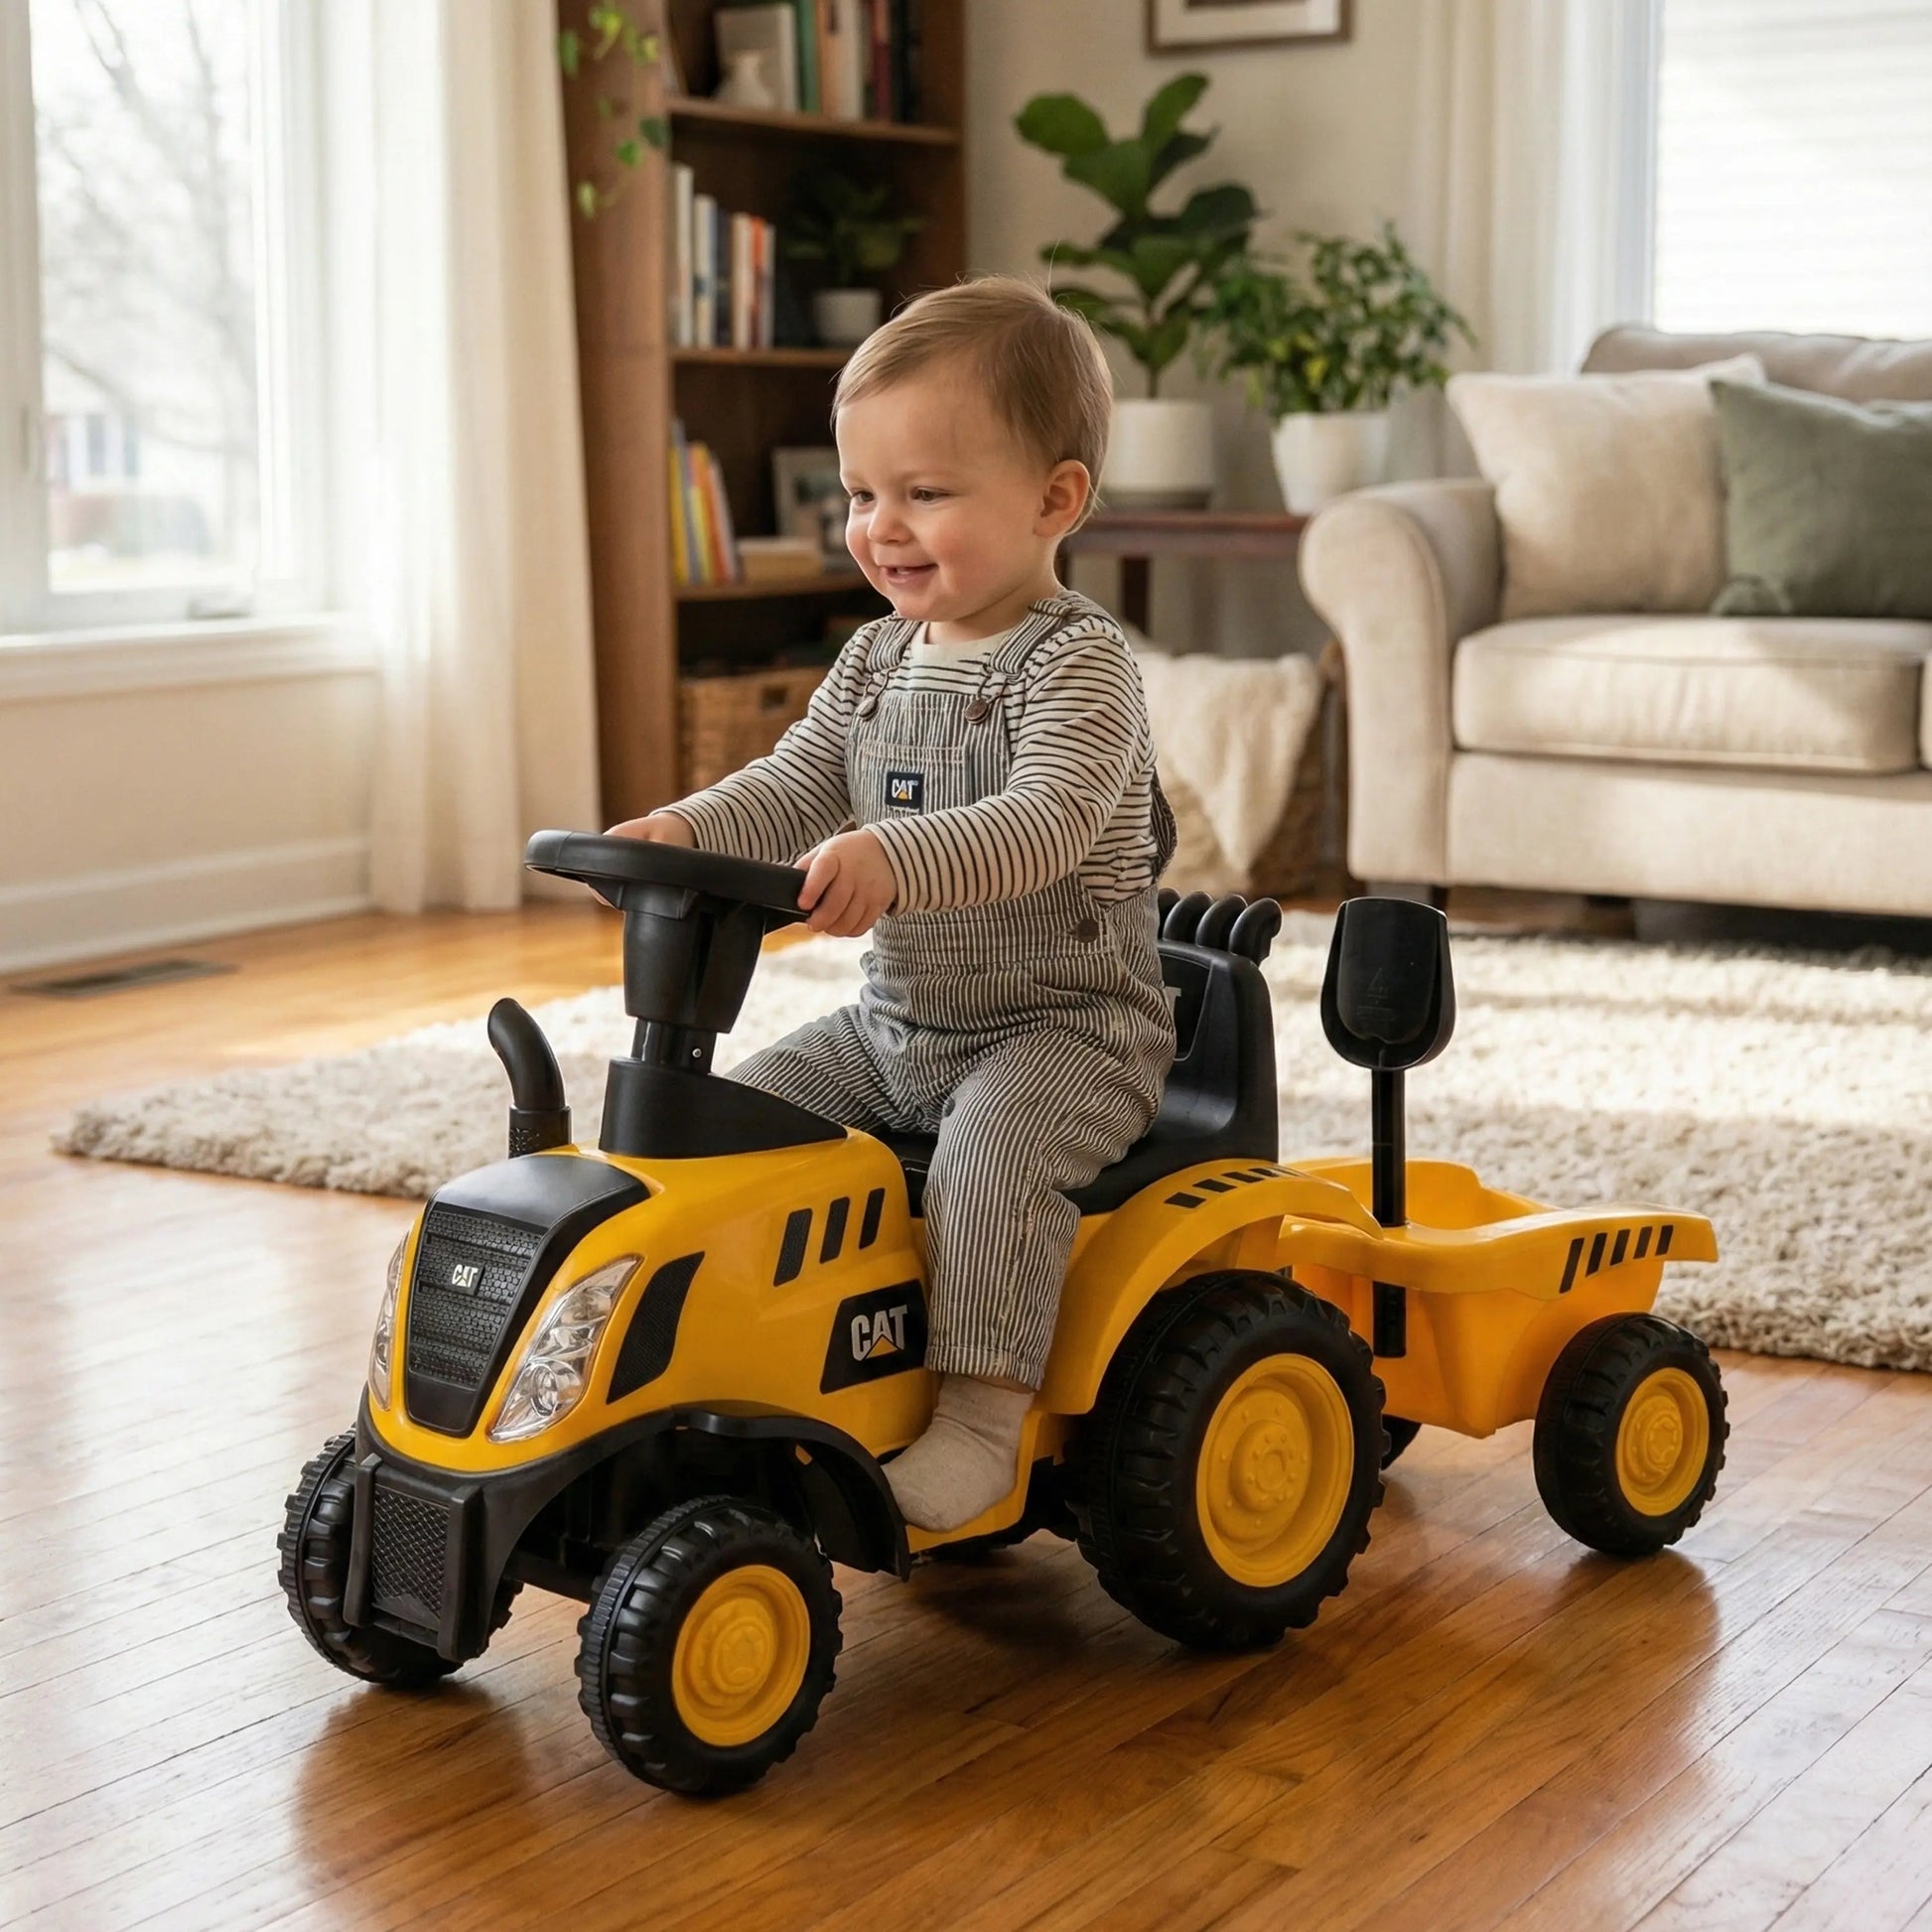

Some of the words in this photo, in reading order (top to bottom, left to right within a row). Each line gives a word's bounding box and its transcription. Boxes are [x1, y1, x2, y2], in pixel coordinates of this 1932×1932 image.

[892, 778, 918, 800] CAT
[452, 1264, 479, 1288] CAT
[851, 1304, 907, 1361] CAT
